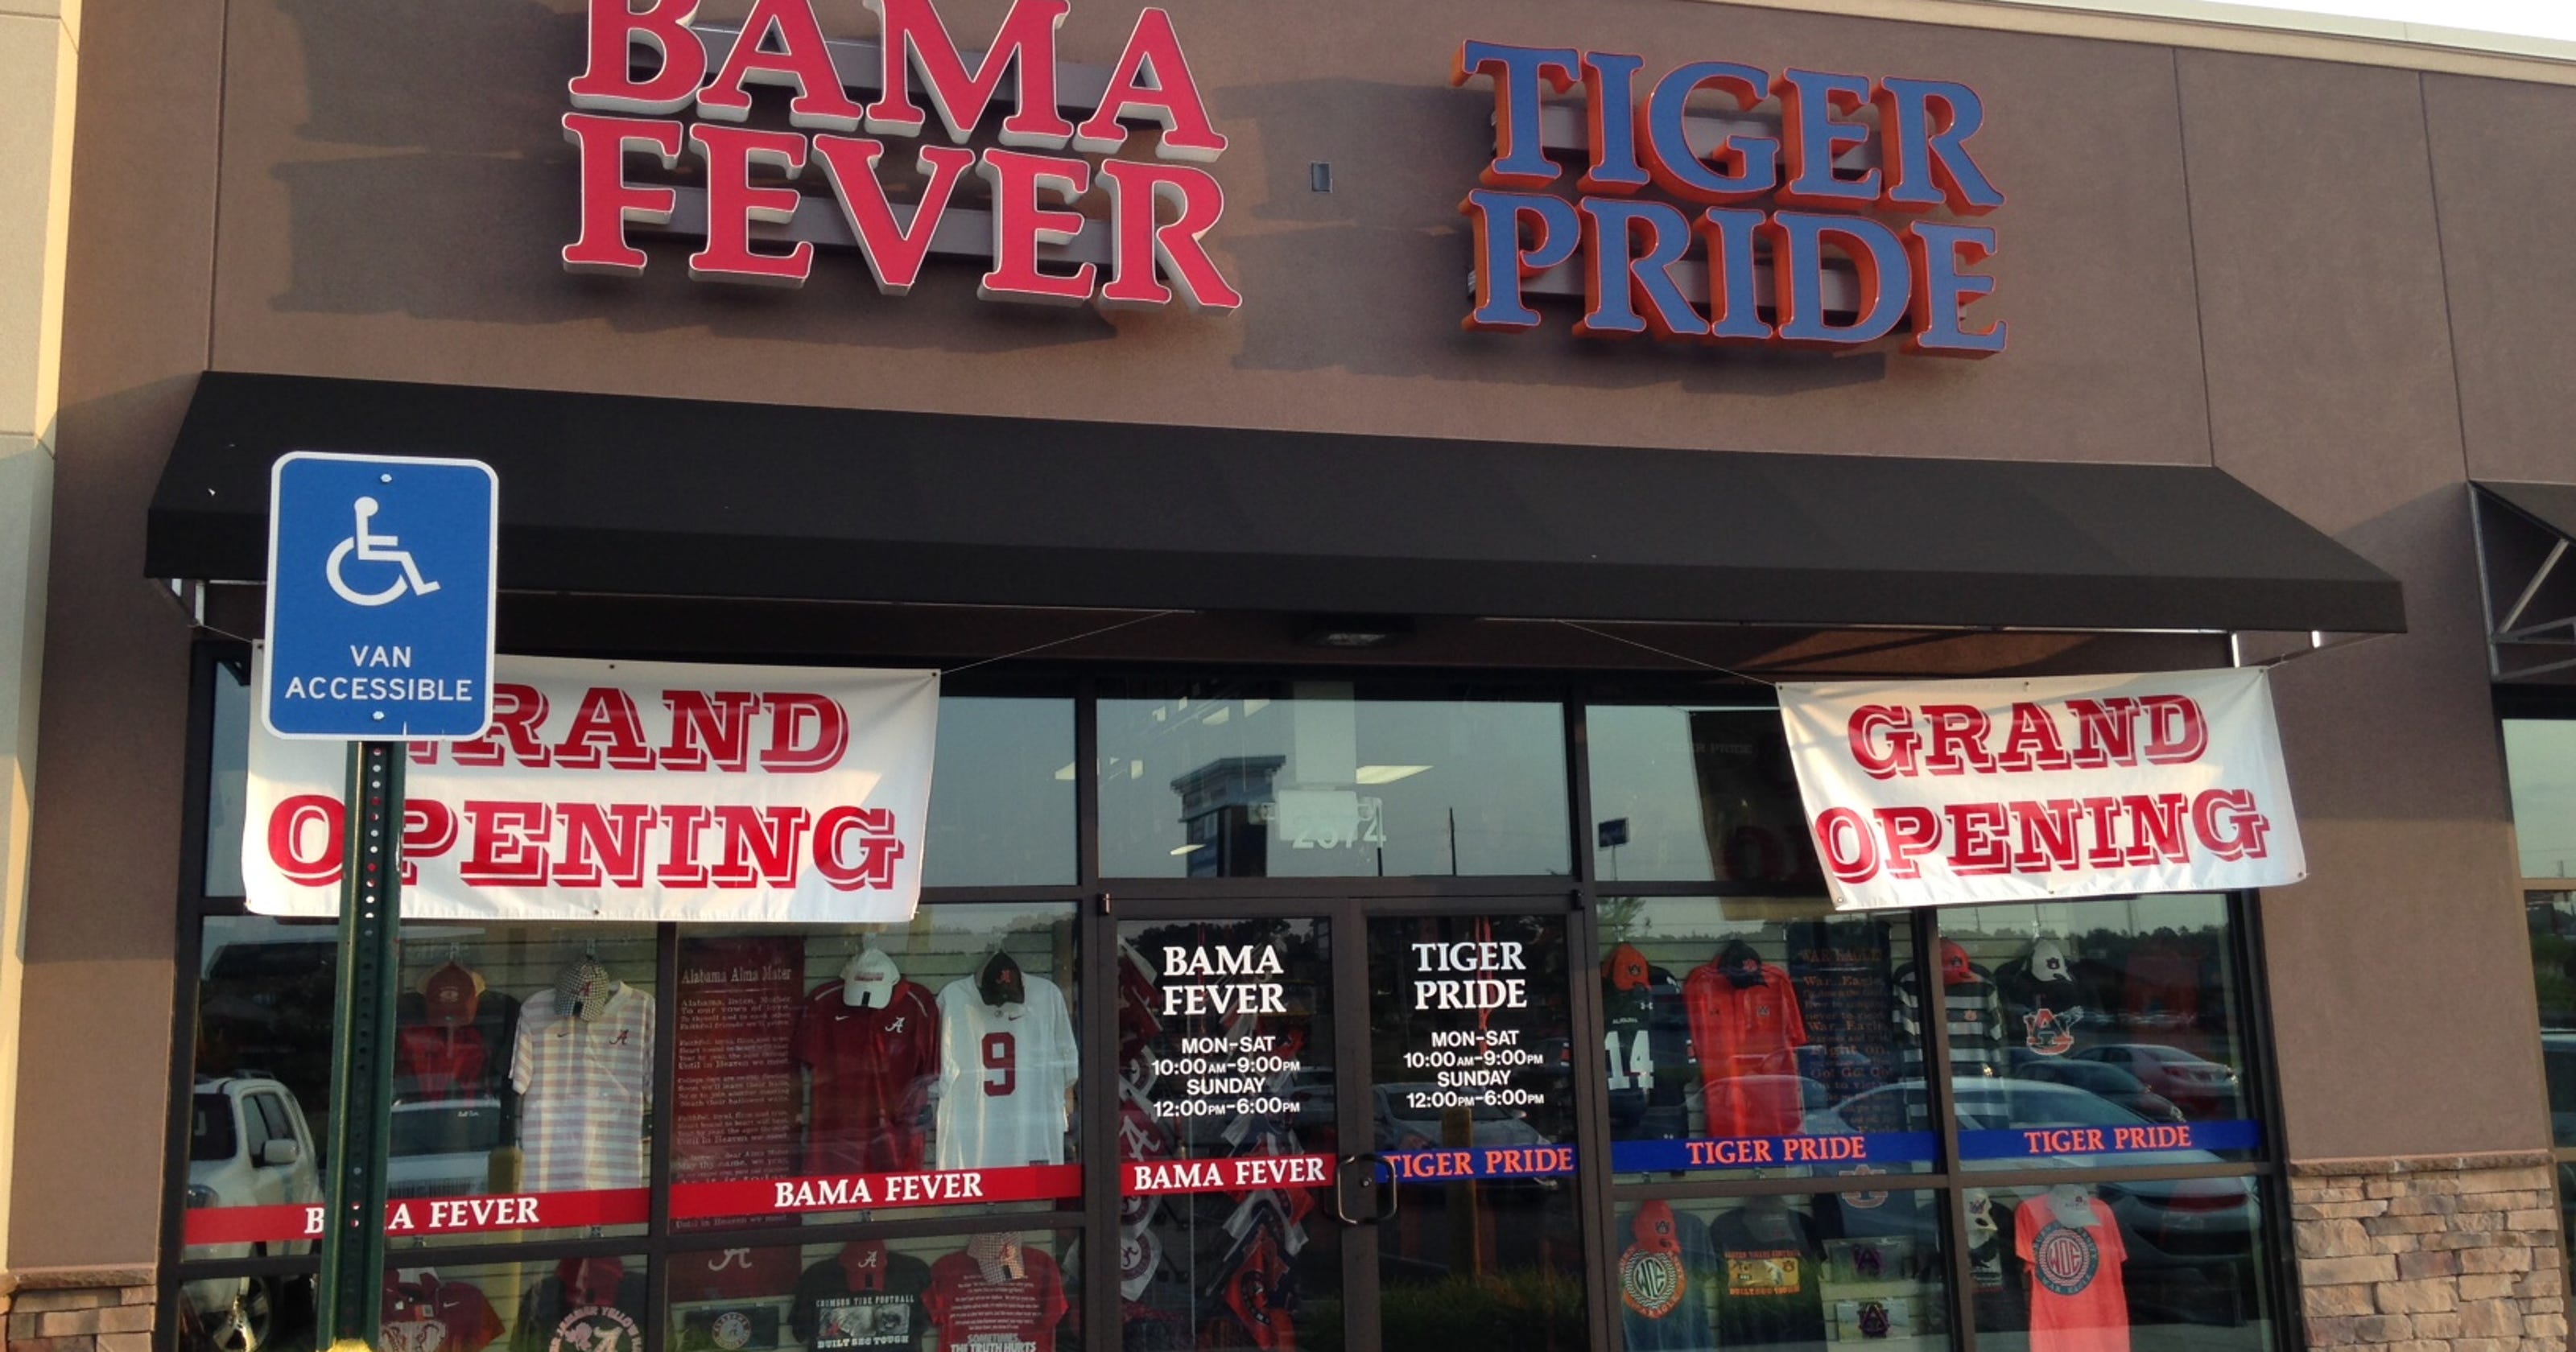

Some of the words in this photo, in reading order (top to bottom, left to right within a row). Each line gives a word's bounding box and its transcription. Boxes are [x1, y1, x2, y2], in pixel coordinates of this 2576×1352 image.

[568, 0, 1228, 161] BAMA
[1454, 39, 2006, 216] TIGER
[562, 113, 1242, 314] FEVER
[1458, 188, 2008, 359] PRIDE
[350, 645, 411, 669] VAN
[286, 677, 473, 702] ACCESSIBLE
[407, 683, 849, 773] RAND
[1847, 695, 2208, 780] GRAND
[1814, 789, 2270, 884] OPENING
[1163, 945, 1284, 975] BAMA
[1413, 942, 1526, 971] TIGER
[1162, 983, 1286, 1015] FEVER
[1414, 979, 1527, 1010] PRIDE
[1182, 1036, 1276, 1054] MON-SAT
[1431, 1030, 1520, 1047] MON-SAT
[981, 1032, 1016, 1096] 9
[1604, 1030, 1654, 1090] 14
[1187, 1078, 1265, 1095] SUNDAY
[1438, 1070, 1511, 1087] SUNDAY
[1686, 1138, 1772, 1165] TIGER
[1783, 1136, 1867, 1161] PRIDE
[2024, 1128, 2104, 1153] TIGER
[2114, 1124, 2191, 1150] PRIDE
[1134, 1160, 1223, 1191] BAMA
[1235, 1156, 1325, 1187] FEVER
[1386, 1148, 1473, 1180] TIGER
[1485, 1146, 1574, 1174] PRIDE
[774, 1177, 872, 1208] BAMA
[885, 1173, 983, 1202] FEVER
[304, 1206, 415, 1234] BA
[429, 1197, 539, 1228] FEVER
